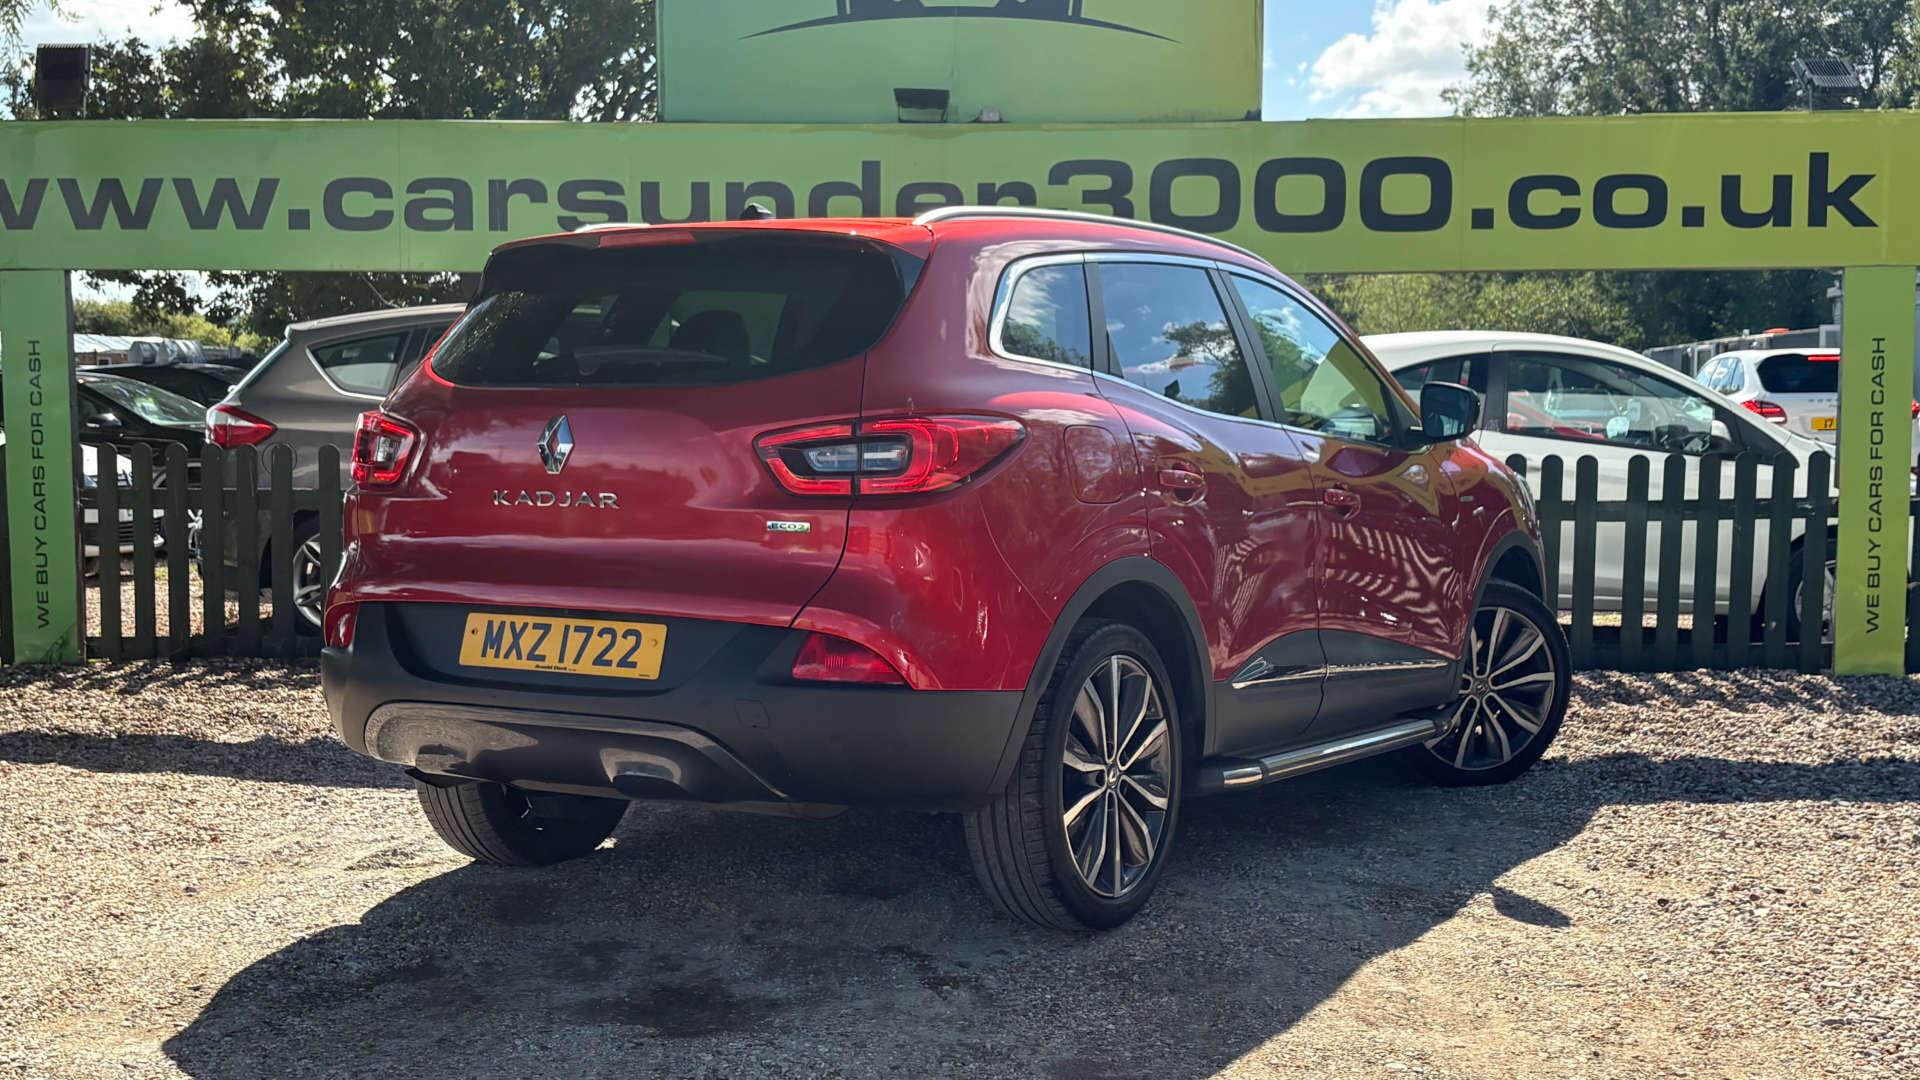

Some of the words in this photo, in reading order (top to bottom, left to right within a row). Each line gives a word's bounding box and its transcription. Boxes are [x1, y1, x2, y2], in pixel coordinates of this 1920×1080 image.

[27, 339, 43, 407] CASH
[1870, 337, 1886, 406] CASH
[30, 411, 45, 460] FOR
[1869, 410, 1885, 461] FOR
[32, 465, 47, 531] CARS
[493, 489, 620, 509] KADJAR
[1868, 465, 1884, 533] CARS
[34, 535, 49, 586] BUY
[1867, 537, 1882, 589] BUY
[36, 590, 50, 630] WE
[1866, 593, 1880, 635] WE
